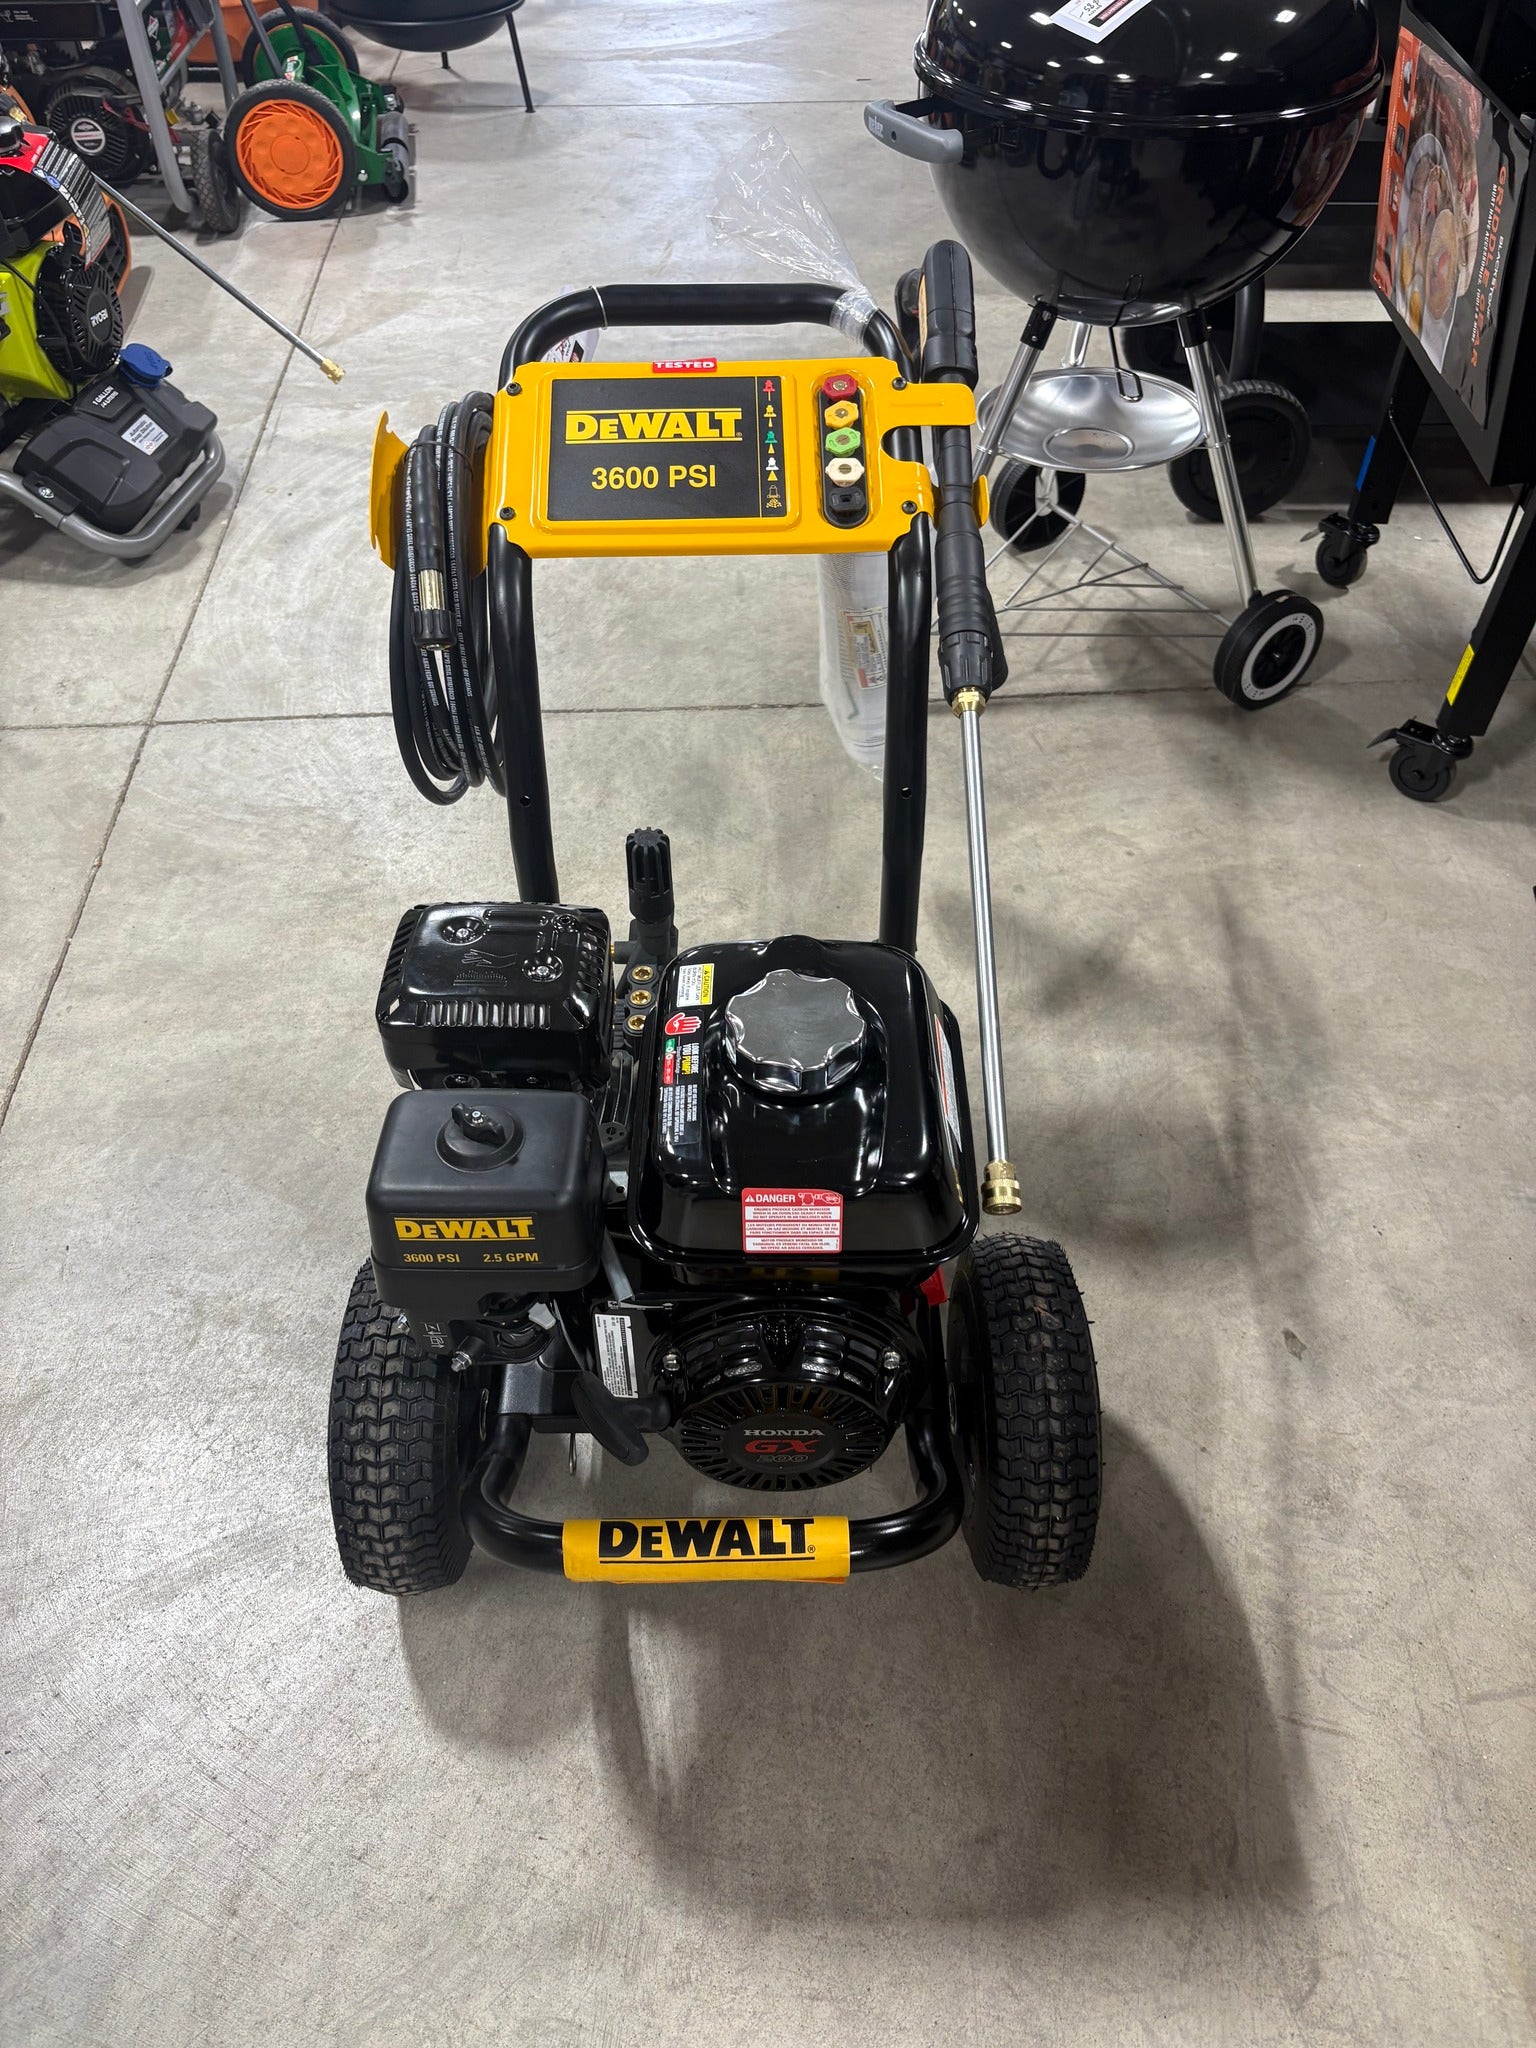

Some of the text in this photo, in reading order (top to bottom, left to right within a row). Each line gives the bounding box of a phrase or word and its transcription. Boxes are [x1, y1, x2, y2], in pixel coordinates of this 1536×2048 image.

[1486, 208, 1494, 230] HAVE
[1471, 166, 1506, 369] GRIDDLE GEAR
[1487, 235, 1504, 320] BLACKSTONE
[90, 308, 109, 328] RYOBI
[655, 361, 715, 369] TESTED
[94, 385, 114, 403] GALLON
[591, 464, 716, 490] 3600 PSI
[702, 975, 710, 998] CAUTION
[681, 1043, 692, 1075] YOU PUMP!
[691, 1042, 700, 1074] LOOK BEFORE
[755, 1194, 796, 1203] DANGER
[403, 1252, 539, 1263] 3600 PSI 2.5 GPM
[744, 1439, 820, 1454] GX
